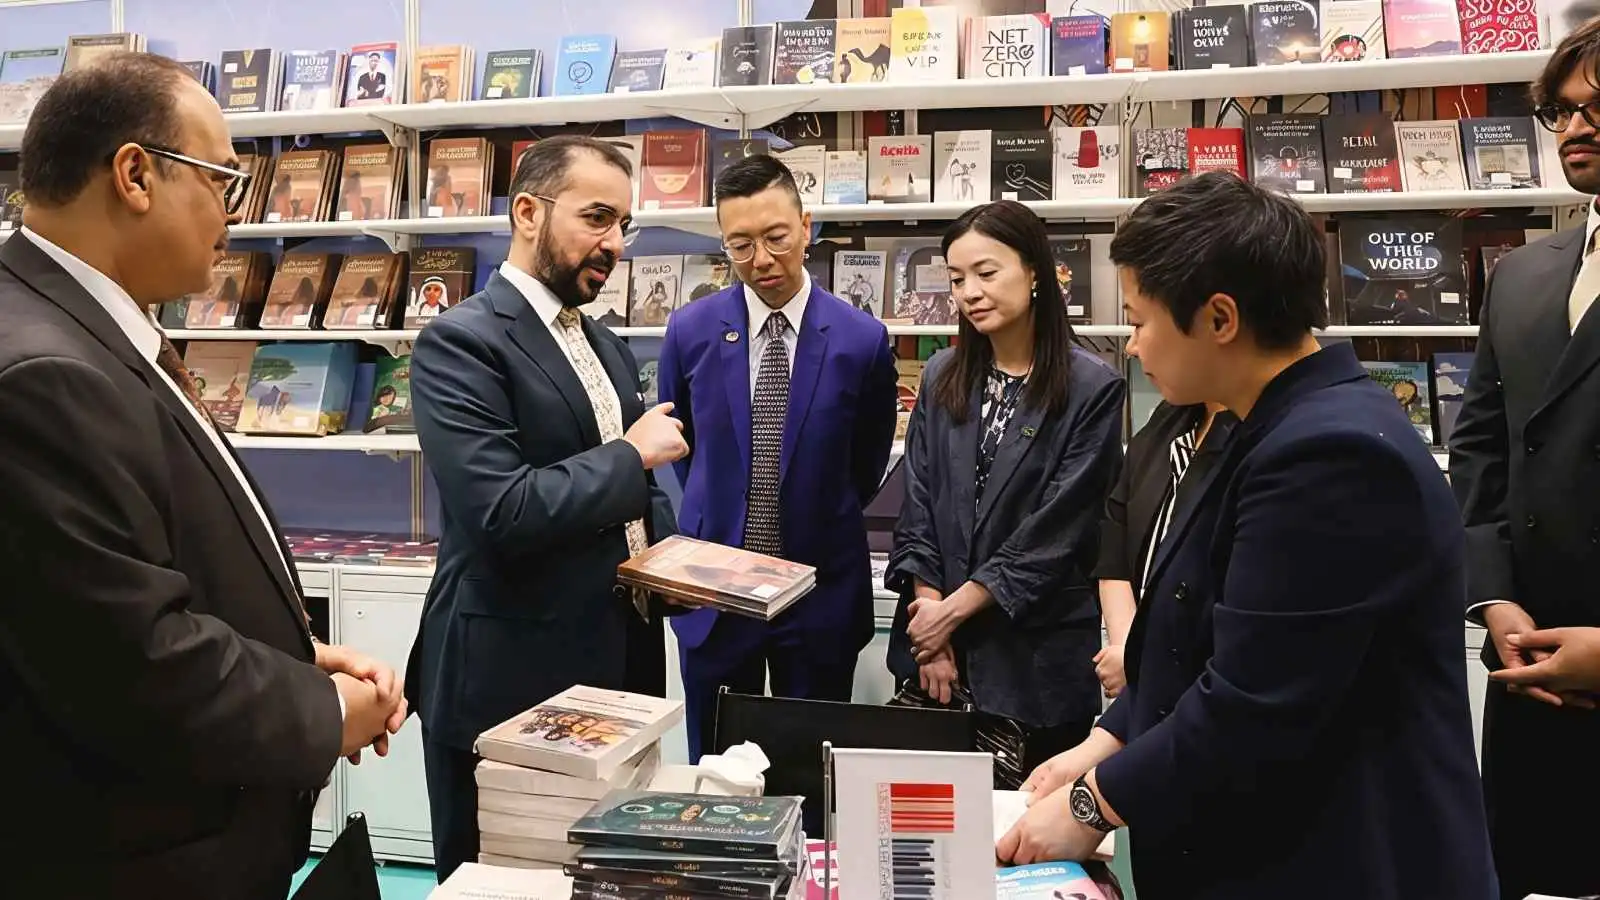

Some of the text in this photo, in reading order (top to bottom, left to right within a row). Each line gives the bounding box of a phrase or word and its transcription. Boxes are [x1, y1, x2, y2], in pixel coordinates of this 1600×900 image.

[988, 29, 1030, 44] NET
[985, 61, 1032, 78] CITY
[1368, 232, 1435, 245] OUT OF
[1368, 257, 1438, 271] WORLD
